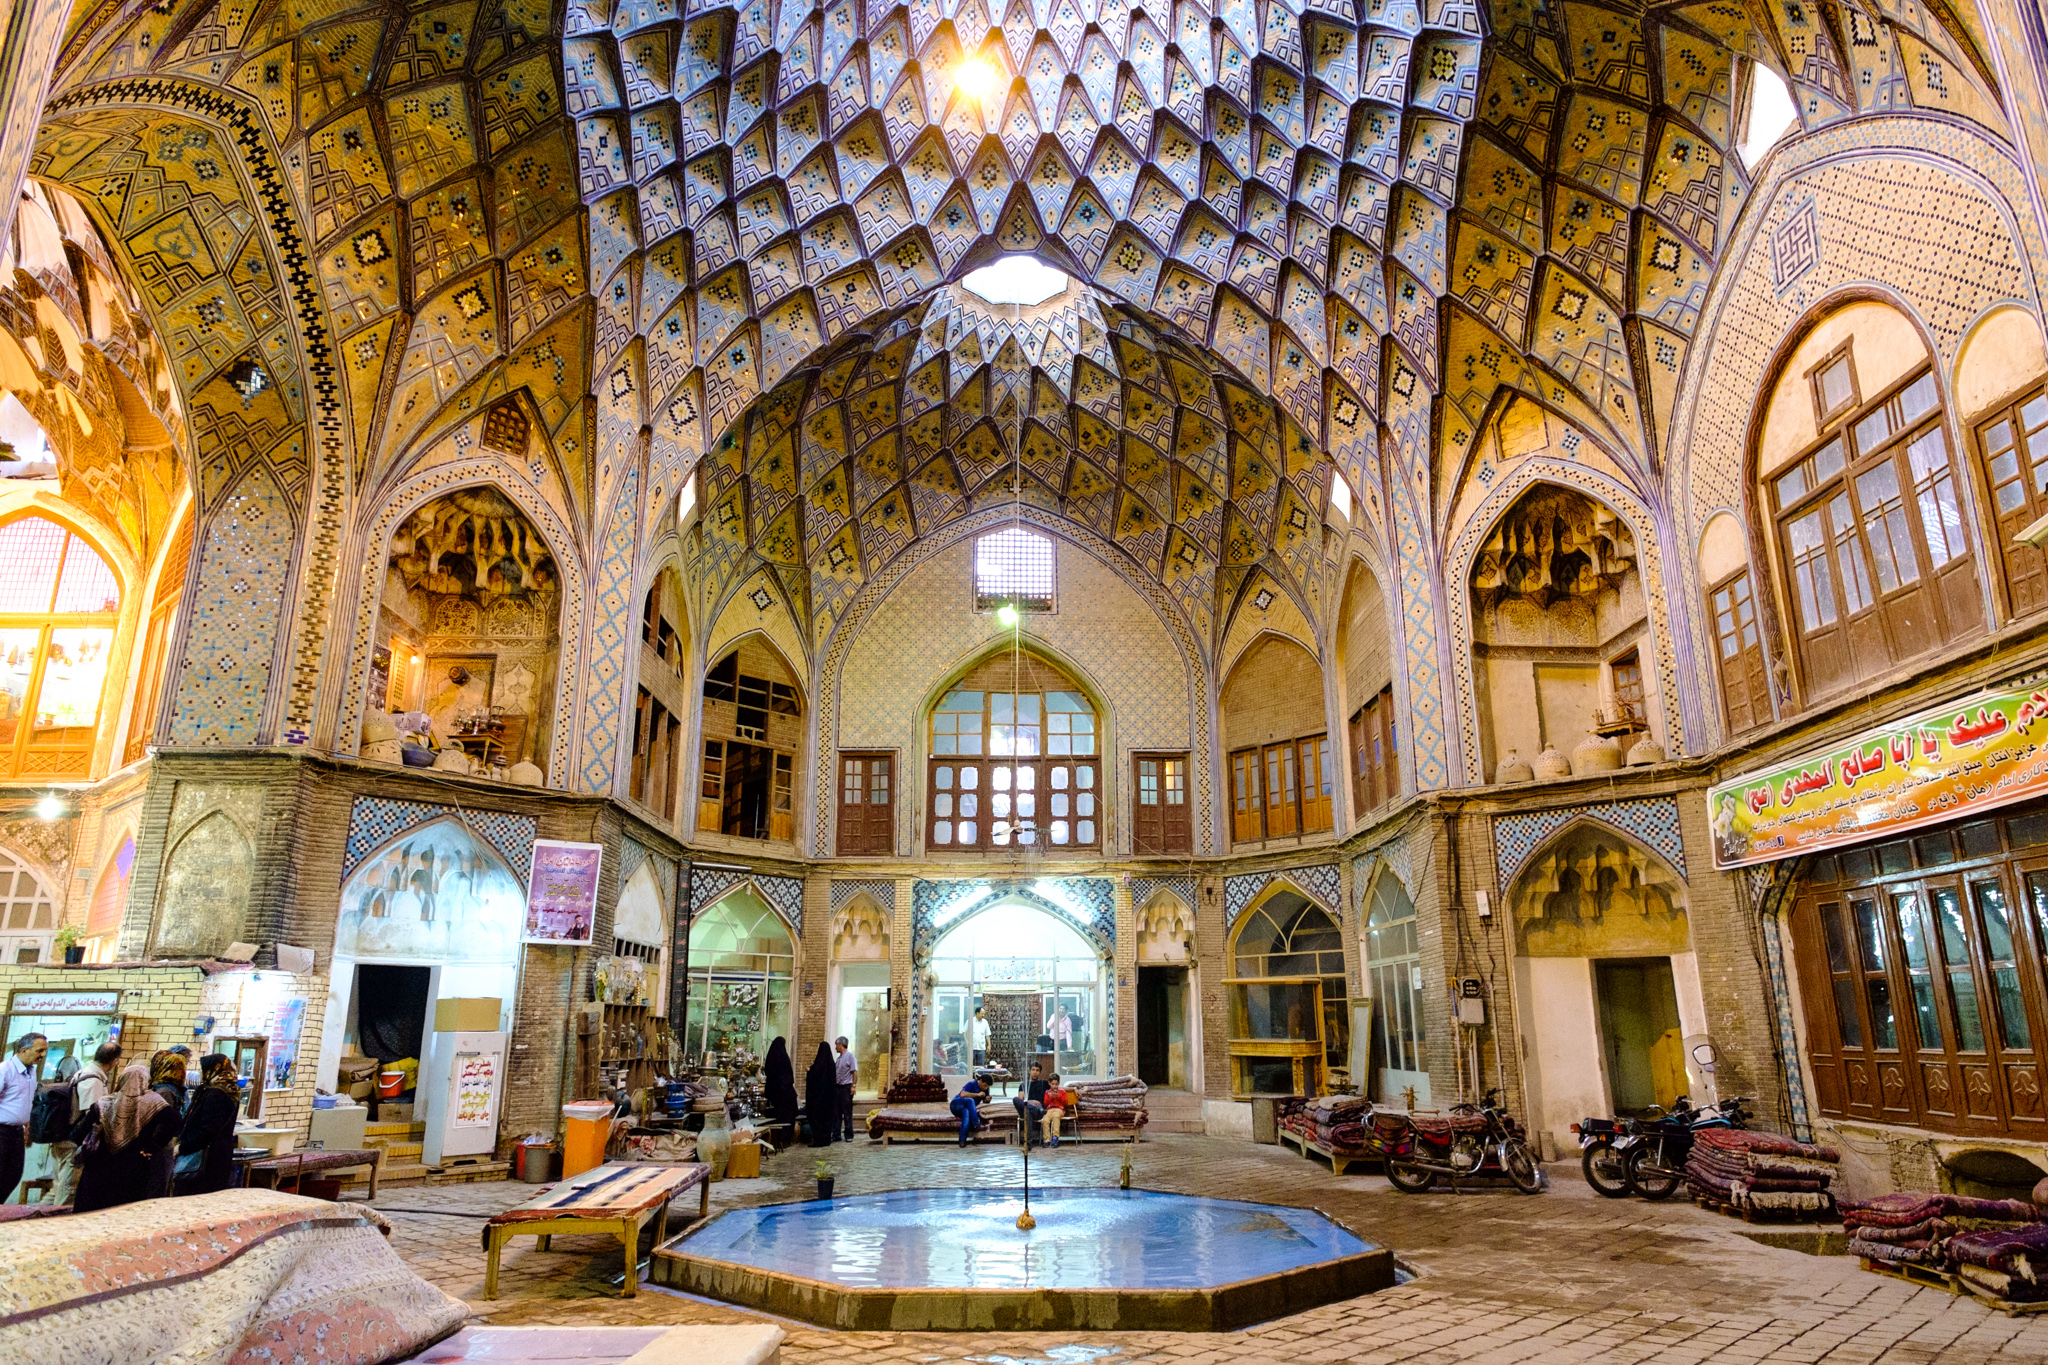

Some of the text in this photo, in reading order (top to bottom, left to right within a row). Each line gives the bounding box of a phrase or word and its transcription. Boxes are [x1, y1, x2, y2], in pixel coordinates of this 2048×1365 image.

[1946, 707, 2008, 749] علیک
[1890, 732, 1913, 770] ابا
[1918, 728, 1940, 762] یا
[1840, 746, 1884, 788] صالح
[1780, 757, 1835, 807] المهدی
[1966, 781, 1993, 800] زمان
[1996, 772, 2016, 793] امام
[1744, 781, 1775, 815] (عج)
[1928, 798, 1938, 810] در
[1938, 792, 1958, 807] واقع
[1893, 801, 1920, 818] خیابان
[14, 997, 32, 1009] آمدید
[31, 998, 47, 1010] خوش
